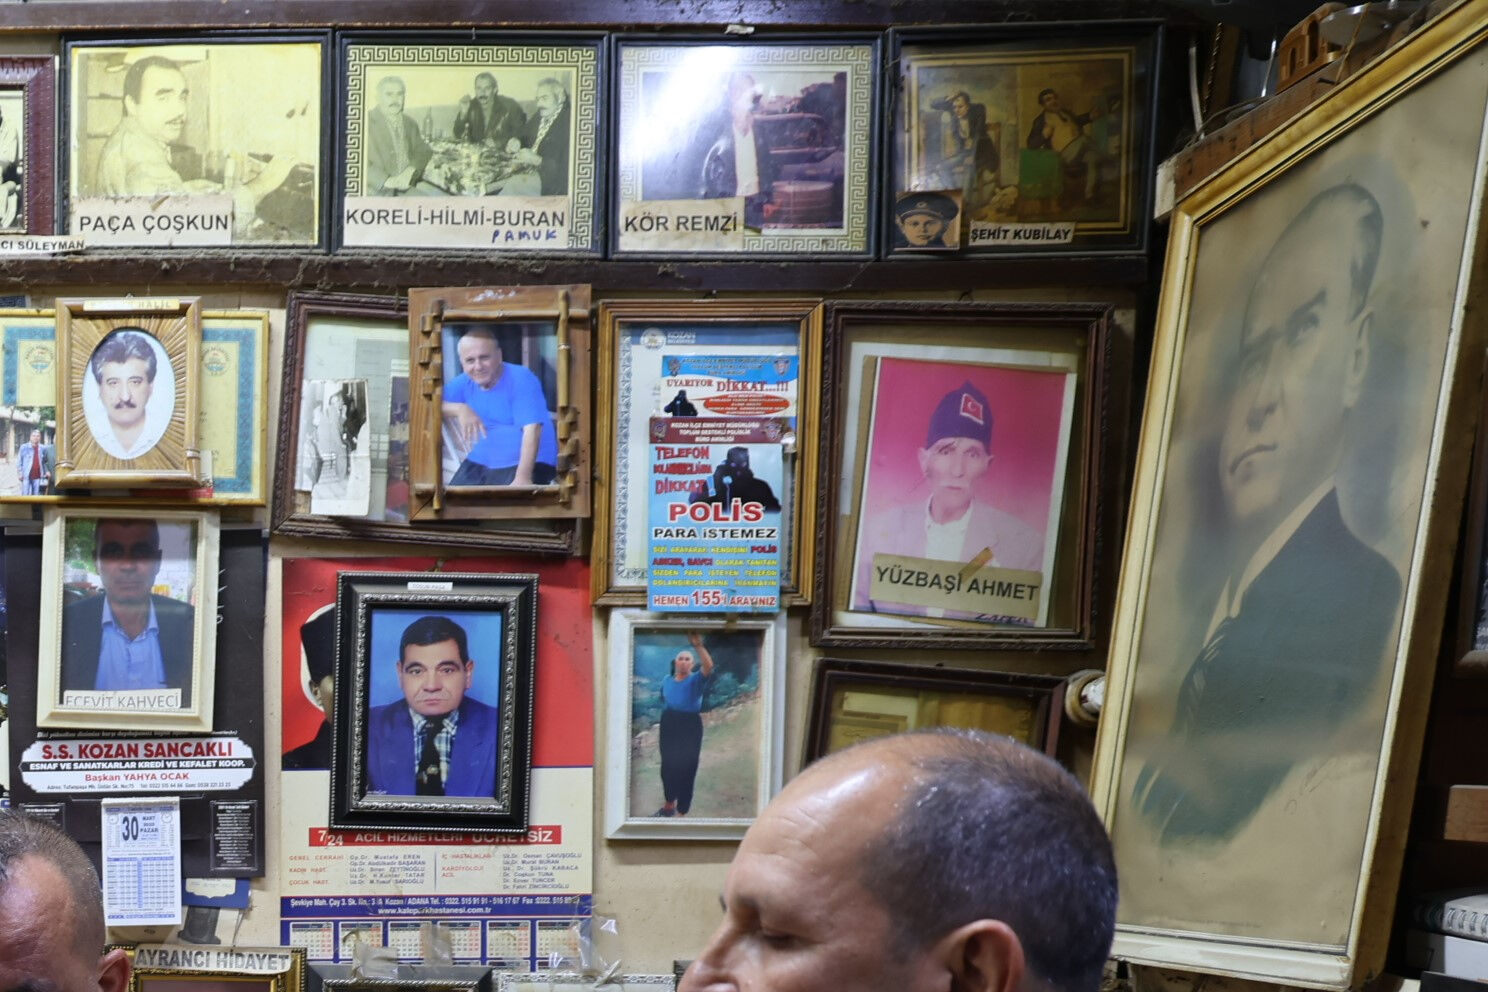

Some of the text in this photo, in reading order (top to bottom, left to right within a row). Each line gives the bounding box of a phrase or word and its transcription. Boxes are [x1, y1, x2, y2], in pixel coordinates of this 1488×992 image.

[80, 212, 229, 234] PAÇA ÇOŞKUN
[346, 206, 565, 227] KORELİ-HİLMİ-BURAN
[625, 211, 738, 232] KÖR REMZİ
[492, 230, 556, 243] PAMUK
[971, 227, 1071, 240] ŞEHİT KUBİLAY
[18, 238, 85, 251] SÜLEYMAN
[667, 379, 713, 388] UYARIYOR
[655, 446, 710, 460] TELEFON
[655, 477, 707, 494] DİKKAT
[669, 498, 765, 523] POLİS
[654, 528, 694, 539] PARA
[750, 544, 778, 554] POLİS
[967, 577, 1039, 600] AHMET
[653, 596, 689, 606] HEMEN
[729, 597, 777, 606] ARAYINIZ
[119, 692, 180, 708] KAHVECİ
[42, 741, 233, 760] S.S. KOZAN SANCAKLI
[29, 759, 245, 771] ESNAF VE SANATKARLAR KREDİ VE KEFALET KOOP.
[85, 772, 190, 783] Başkan YAHYA OCAK
[122, 815, 140, 841] 30
[290, 898, 314, 908] Şevkiye
[328, 898, 341, 907] Çay
[407, 897, 430, 905] ADANA
[136, 950, 290, 971] AYRANCI HİDAYET
